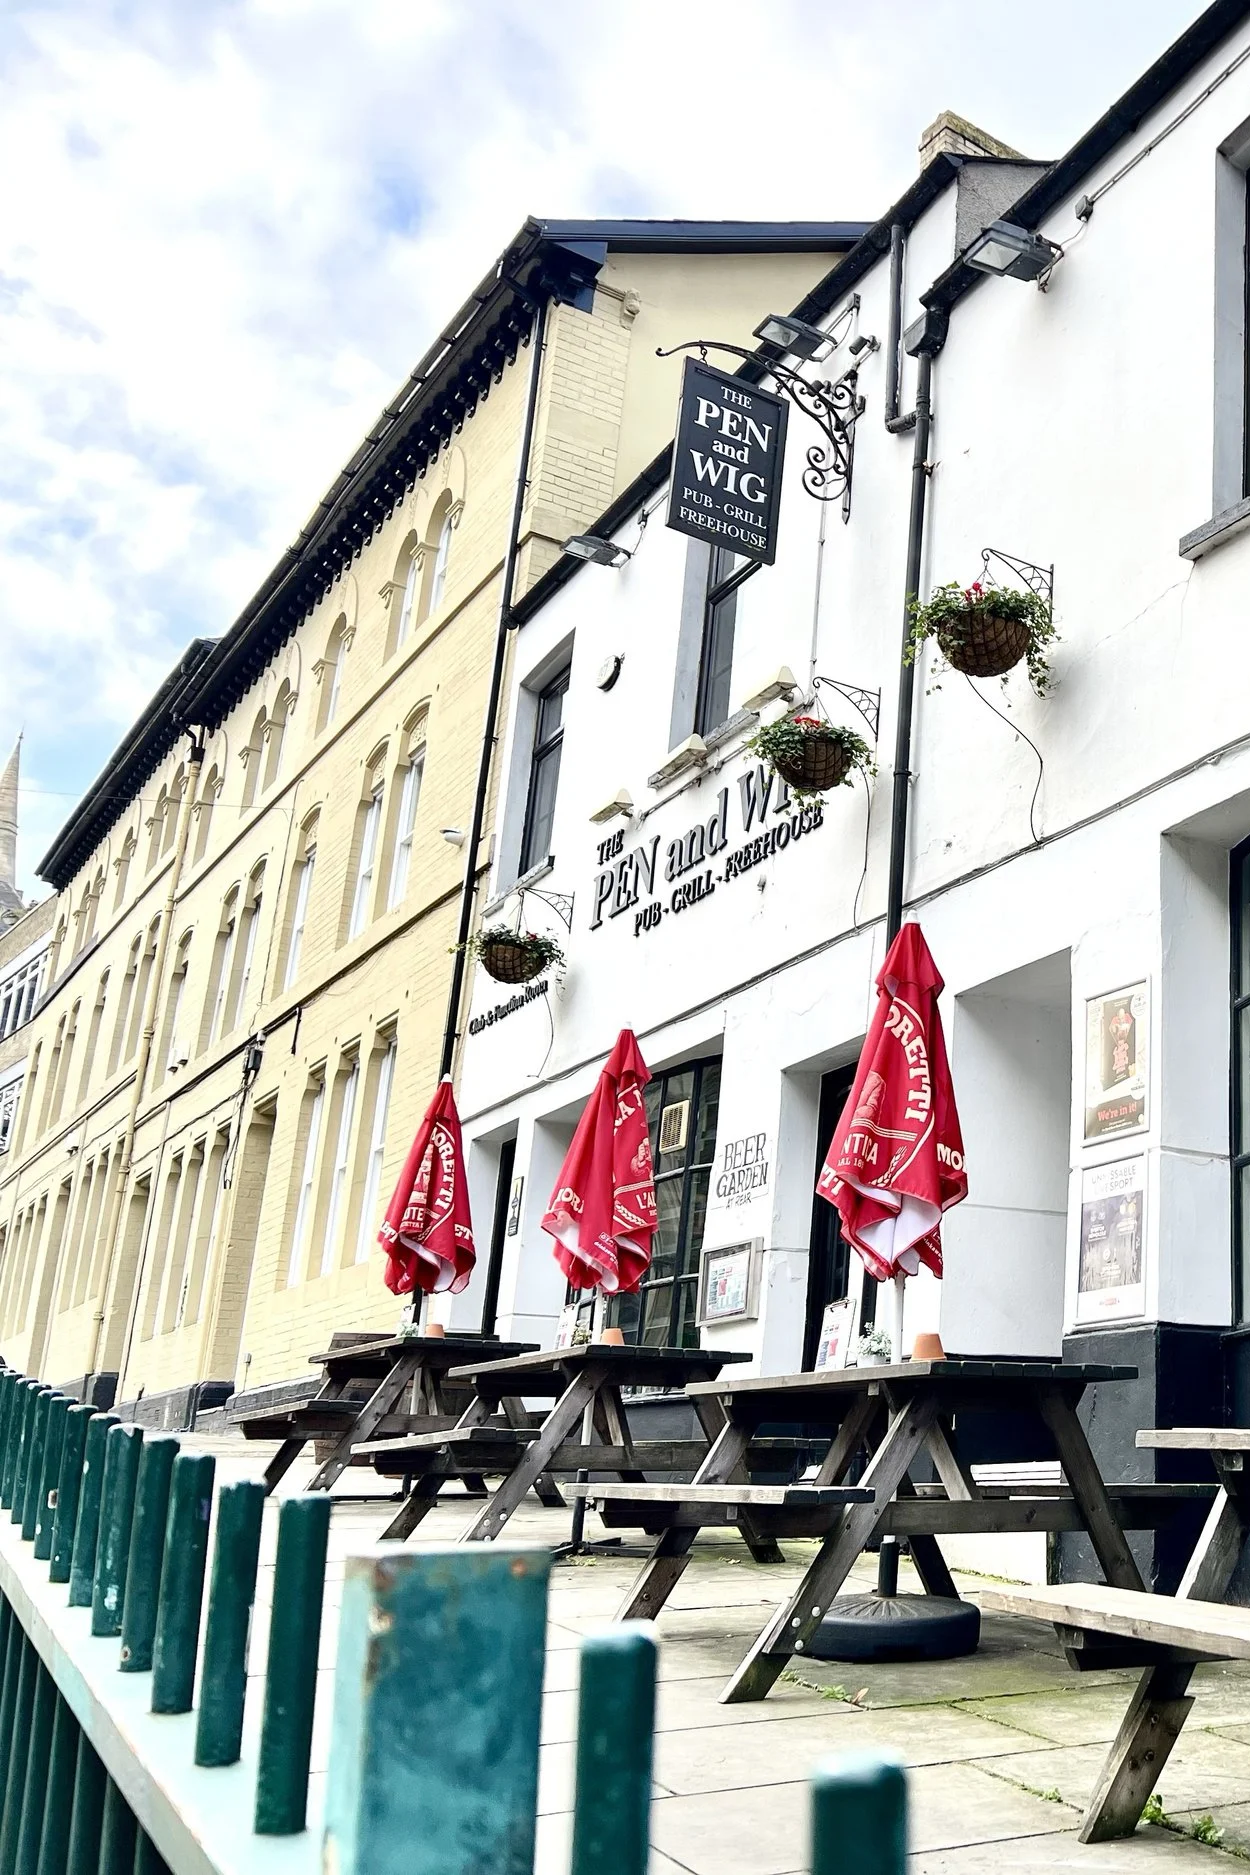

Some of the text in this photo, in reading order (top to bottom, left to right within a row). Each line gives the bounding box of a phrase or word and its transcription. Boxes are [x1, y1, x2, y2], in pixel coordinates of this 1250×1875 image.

[721, 386, 752, 409] THE
[694, 396, 773, 453] PEN
[712, 439, 749, 464] and
[689, 449, 768, 503] WIG
[683, 486, 713, 509] PUB
[723, 503, 767, 529] GRILL
[680, 506, 767, 549] FREEHOUSE
[589, 763, 793, 931] PEN and WI
[596, 828, 625, 865] THE
[633, 901, 662, 937] PUB
[671, 869, 716, 914] GRILL
[722, 804, 825, 883] FREEHOUSE
[1119, 1105, 1128, 1116] in
[722, 1132, 767, 1173] BEER
[716, 1162, 769, 1198] GARDEN
[735, 1191, 752, 1207] REAR
[1109, 1176, 1133, 1192] SPORT
